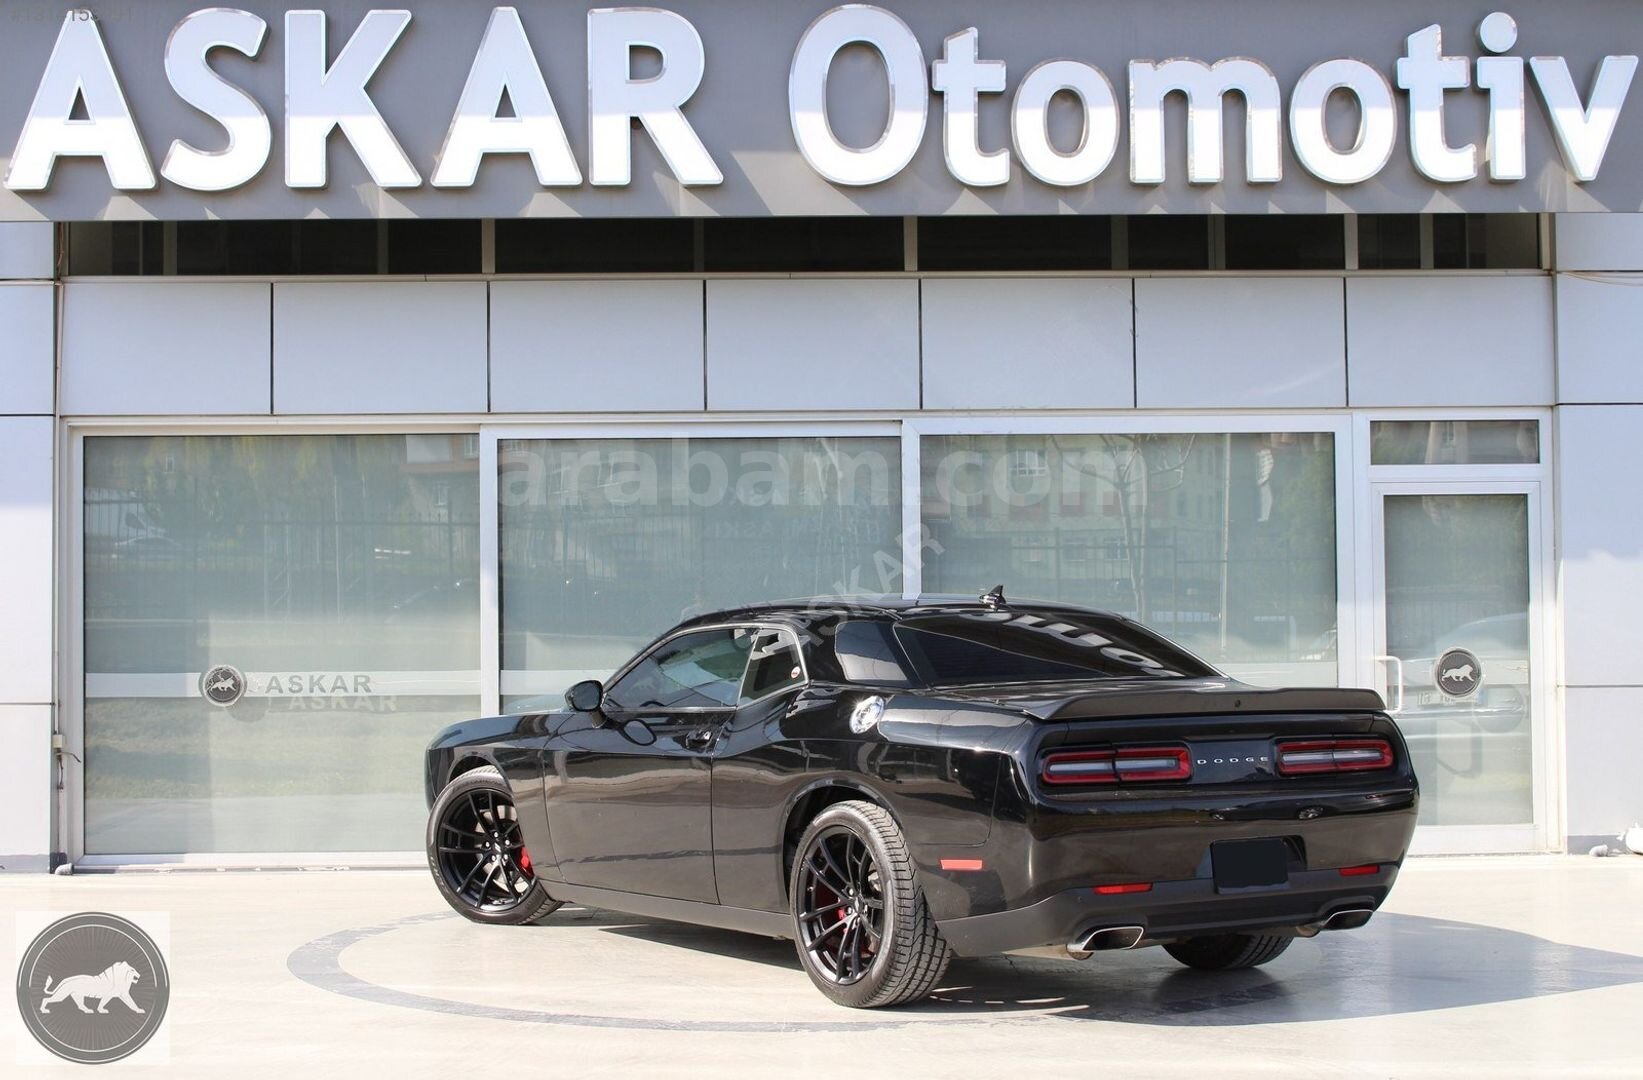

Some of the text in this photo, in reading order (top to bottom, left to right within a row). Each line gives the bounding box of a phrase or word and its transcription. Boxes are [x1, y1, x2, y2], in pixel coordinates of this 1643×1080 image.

[4, 4, 1639, 191] ASKAR Otomotiv
[265, 674, 372, 695] ASKAR
[1197, 756, 1269, 765] DODGE
